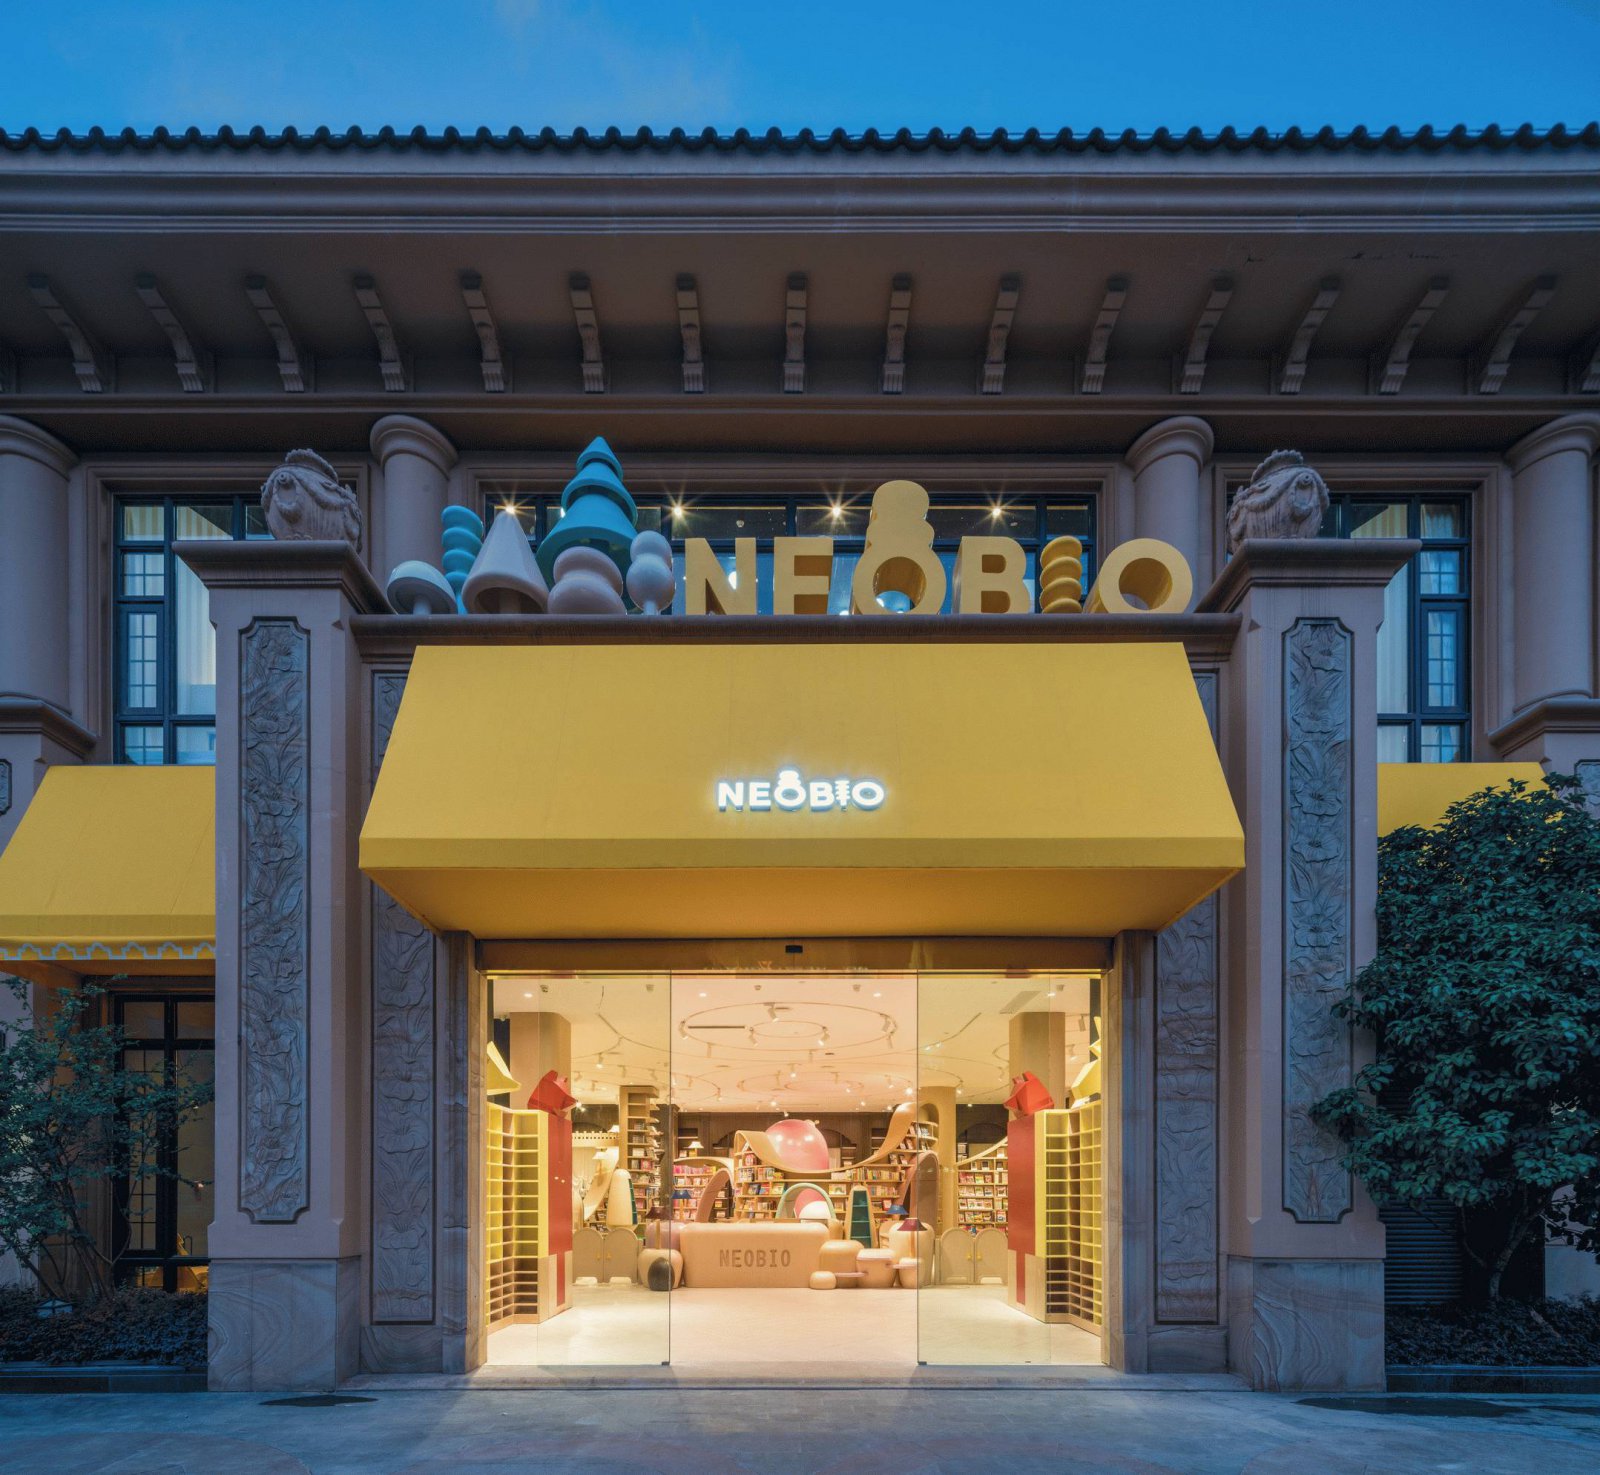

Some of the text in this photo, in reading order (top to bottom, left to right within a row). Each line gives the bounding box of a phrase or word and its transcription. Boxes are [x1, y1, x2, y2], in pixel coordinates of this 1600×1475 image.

[684, 480, 1193, 615] NEOBIO
[717, 770, 885, 811] NEOBIO
[719, 1249, 792, 1268] NEOBIO
